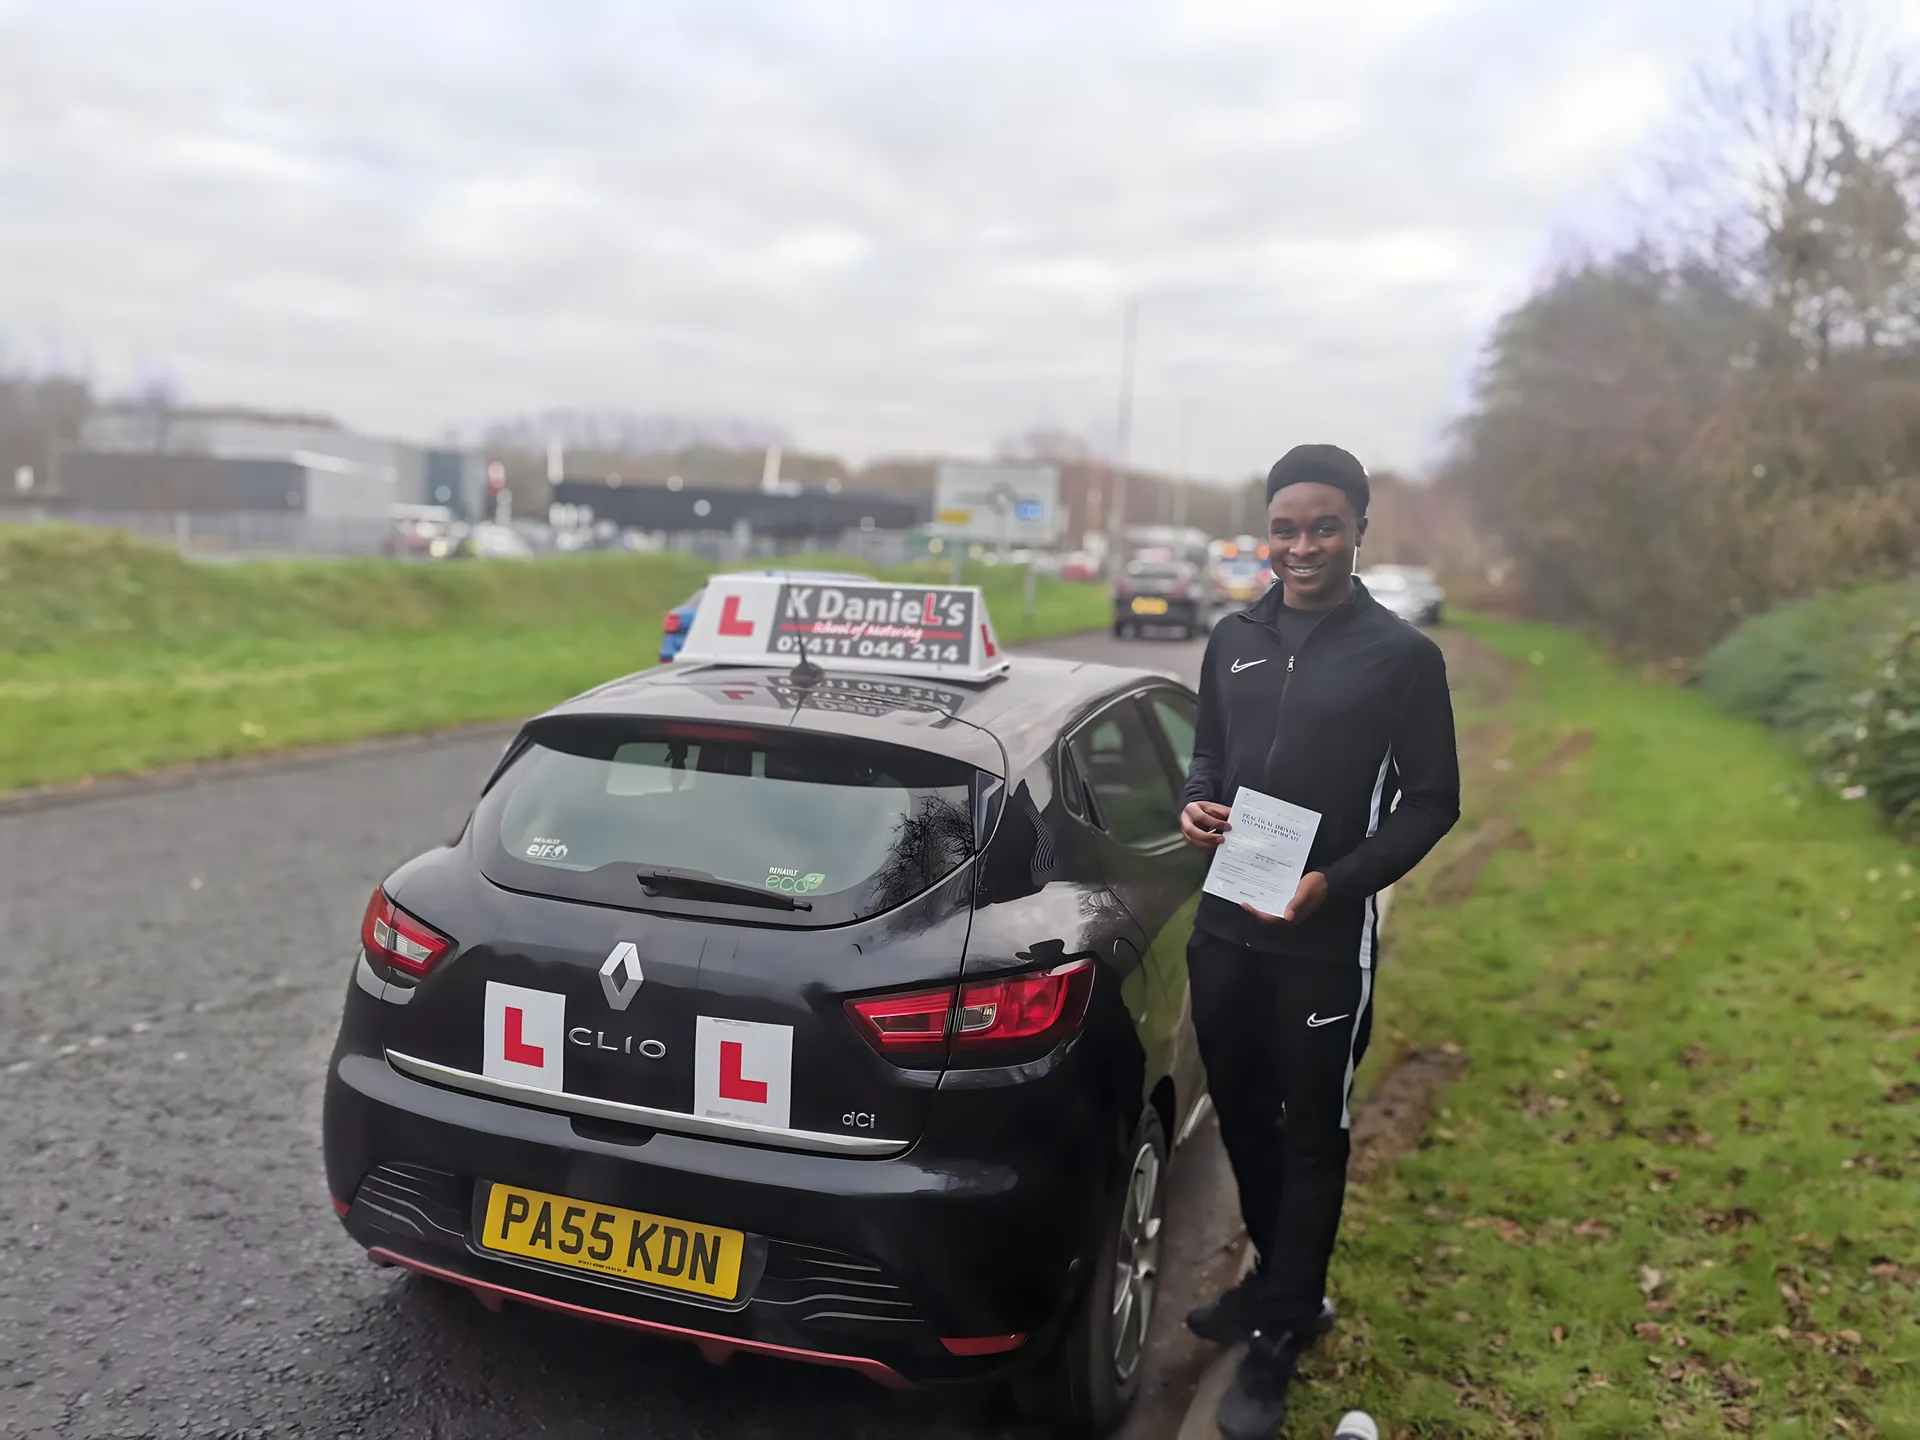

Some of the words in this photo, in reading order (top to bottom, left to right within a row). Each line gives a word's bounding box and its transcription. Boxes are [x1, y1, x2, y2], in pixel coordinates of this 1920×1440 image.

[718, 595, 754, 637] L
[784, 587, 814, 618] K
[857, 639, 906, 657] 044
[910, 643, 960, 662] 214
[979, 623, 996, 659] L
[504, 1006, 544, 1068] L
[568, 1026, 667, 1060] CLIO
[719, 1040, 768, 1104] L
[842, 1111, 876, 1129] dCi
[500, 1193, 616, 1262] PA55
[627, 1219, 722, 1285] KDN
